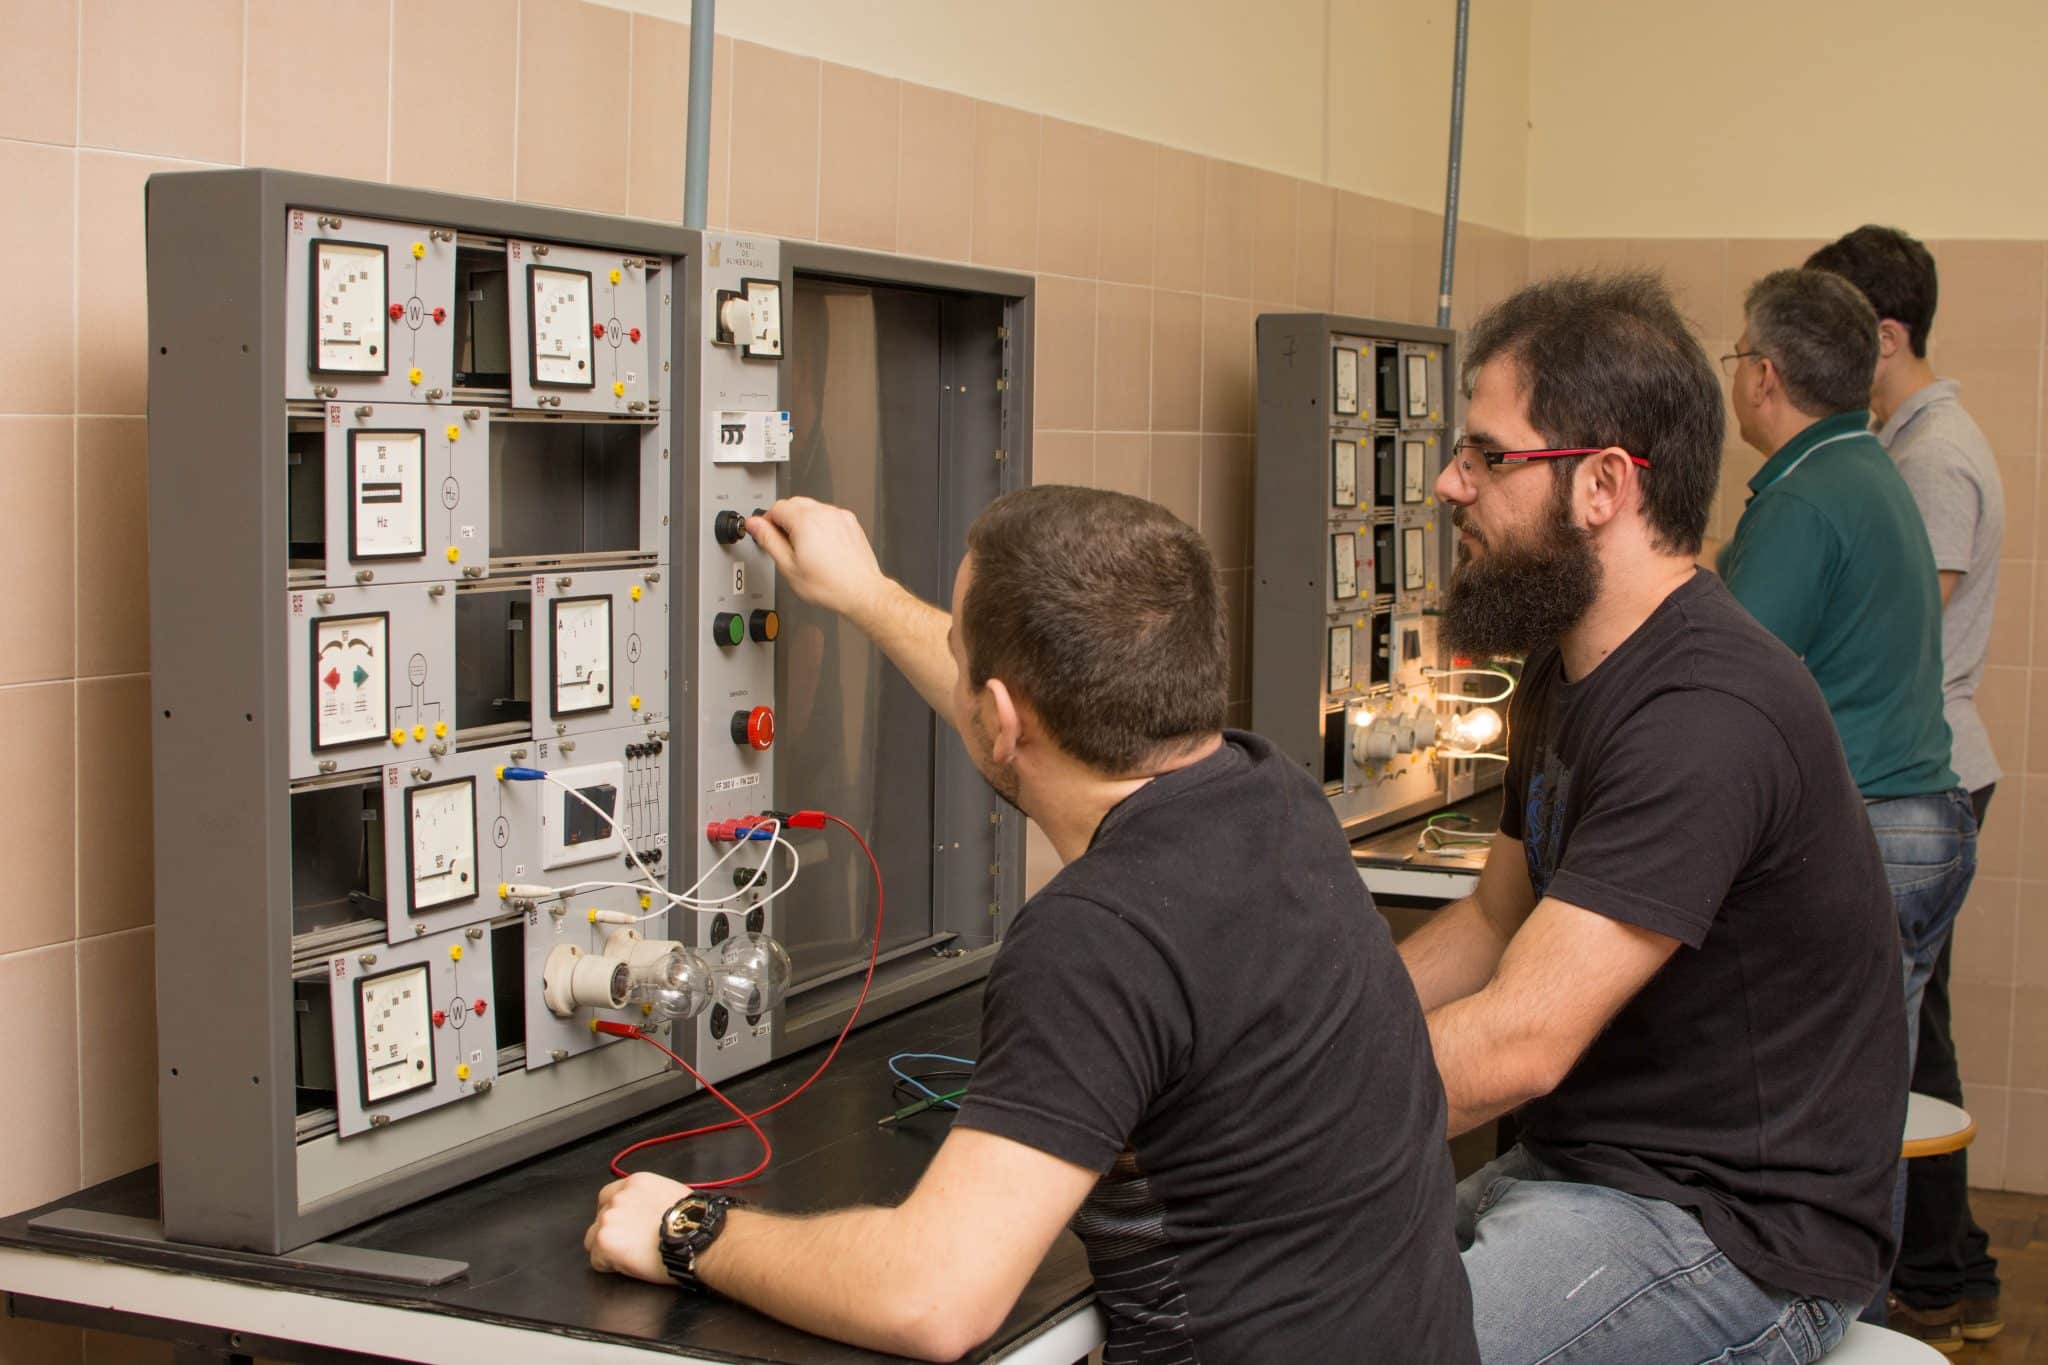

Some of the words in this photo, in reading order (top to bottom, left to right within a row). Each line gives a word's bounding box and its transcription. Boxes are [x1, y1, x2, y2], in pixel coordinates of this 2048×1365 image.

[322, 258, 331, 270] W
[536, 280, 544, 292] W
[409, 306, 420, 321] W
[610, 325, 620, 340] W
[445, 486, 456, 501] Hz
[377, 516, 388, 528] Hz
[735, 569, 743, 591] 8
[630, 641, 637, 656] A
[498, 825, 505, 840] A
[366, 991, 375, 1003] W
[452, 1005, 463, 1021] W
